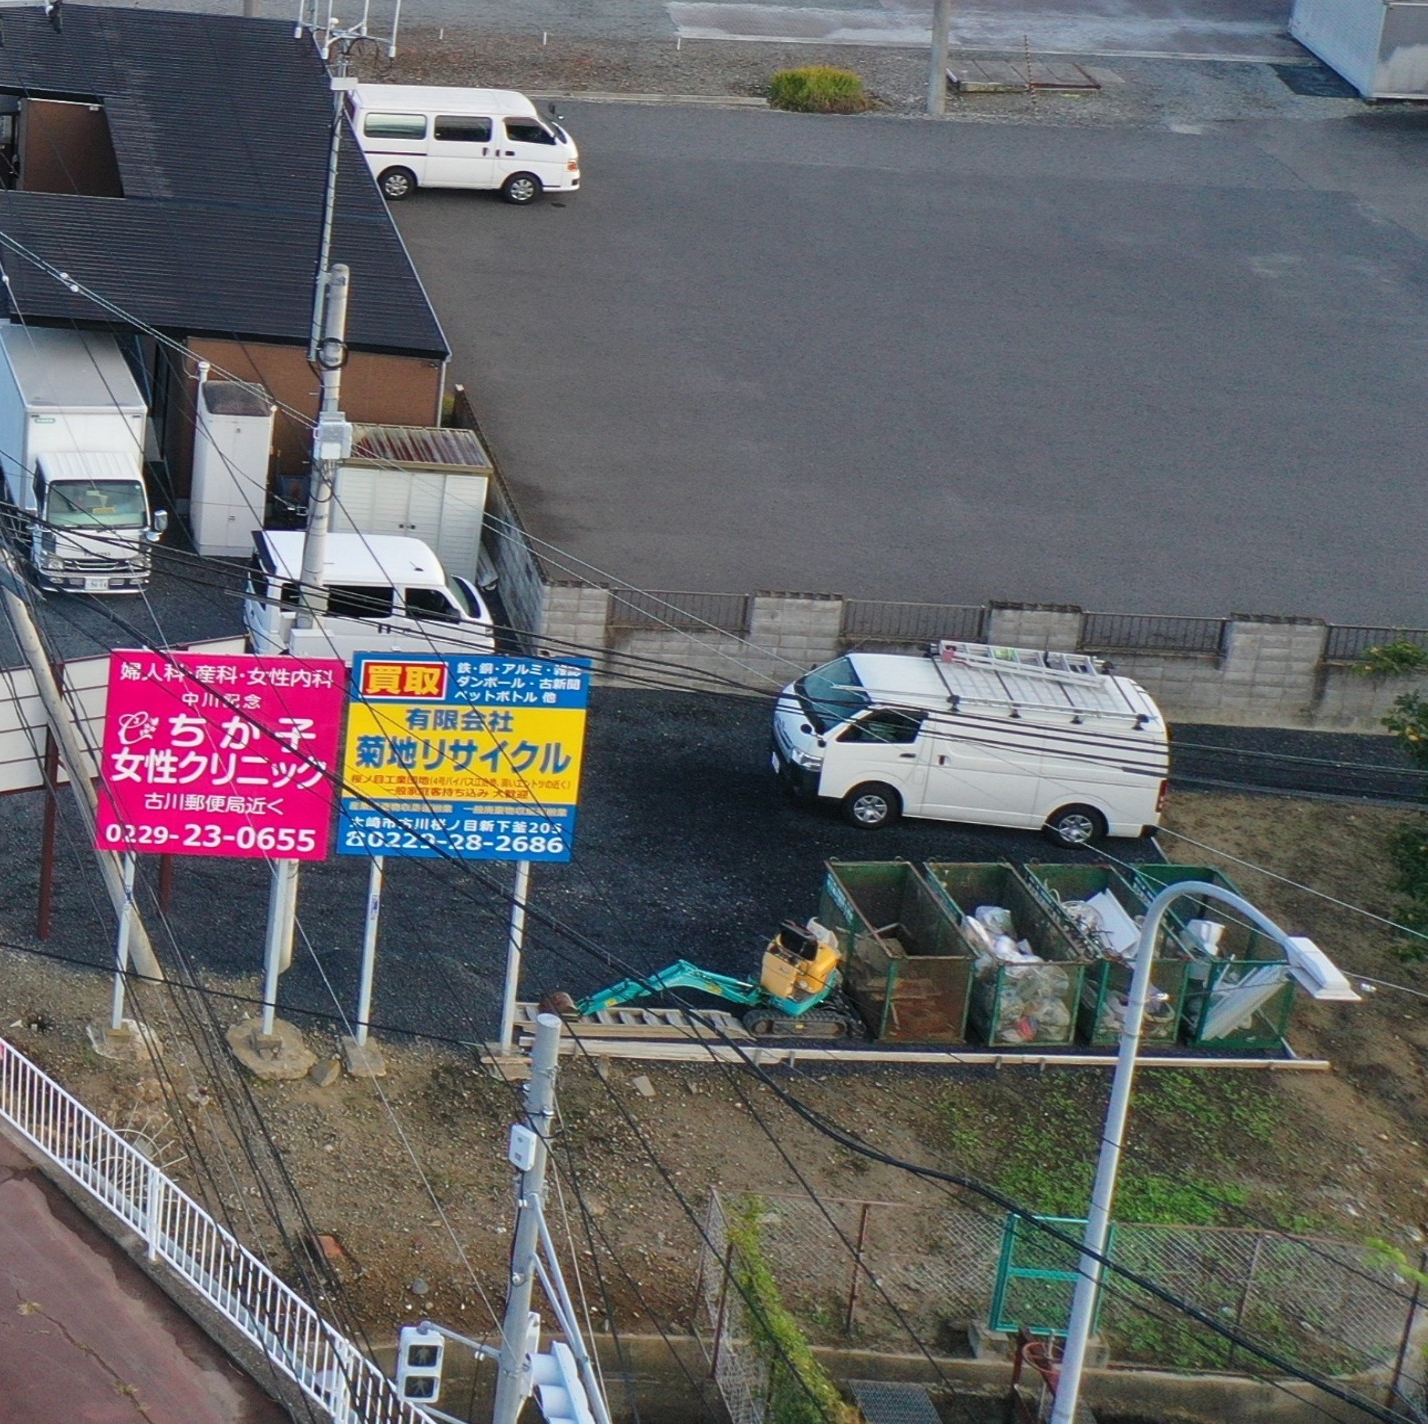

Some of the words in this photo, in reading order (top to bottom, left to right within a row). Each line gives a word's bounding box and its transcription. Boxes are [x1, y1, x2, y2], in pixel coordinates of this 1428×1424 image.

[366, 664, 441, 696] 買取
[456, 676, 582, 691] ダンボール・古新聞
[182, 692, 262, 710] 中川記念
[542, 691, 557, 704] 他
[405, 708, 515, 733] 有限会社
[168, 713, 317, 754] ちか子
[355, 735, 573, 775] 菊地リサイクル
[111, 746, 327, 790] 女性クリニック
[144, 792, 284, 816] 古川郵便局近く
[105, 823, 316, 852] 0229-23-0655
[367, 831, 565, 854] 0229-28-2686
